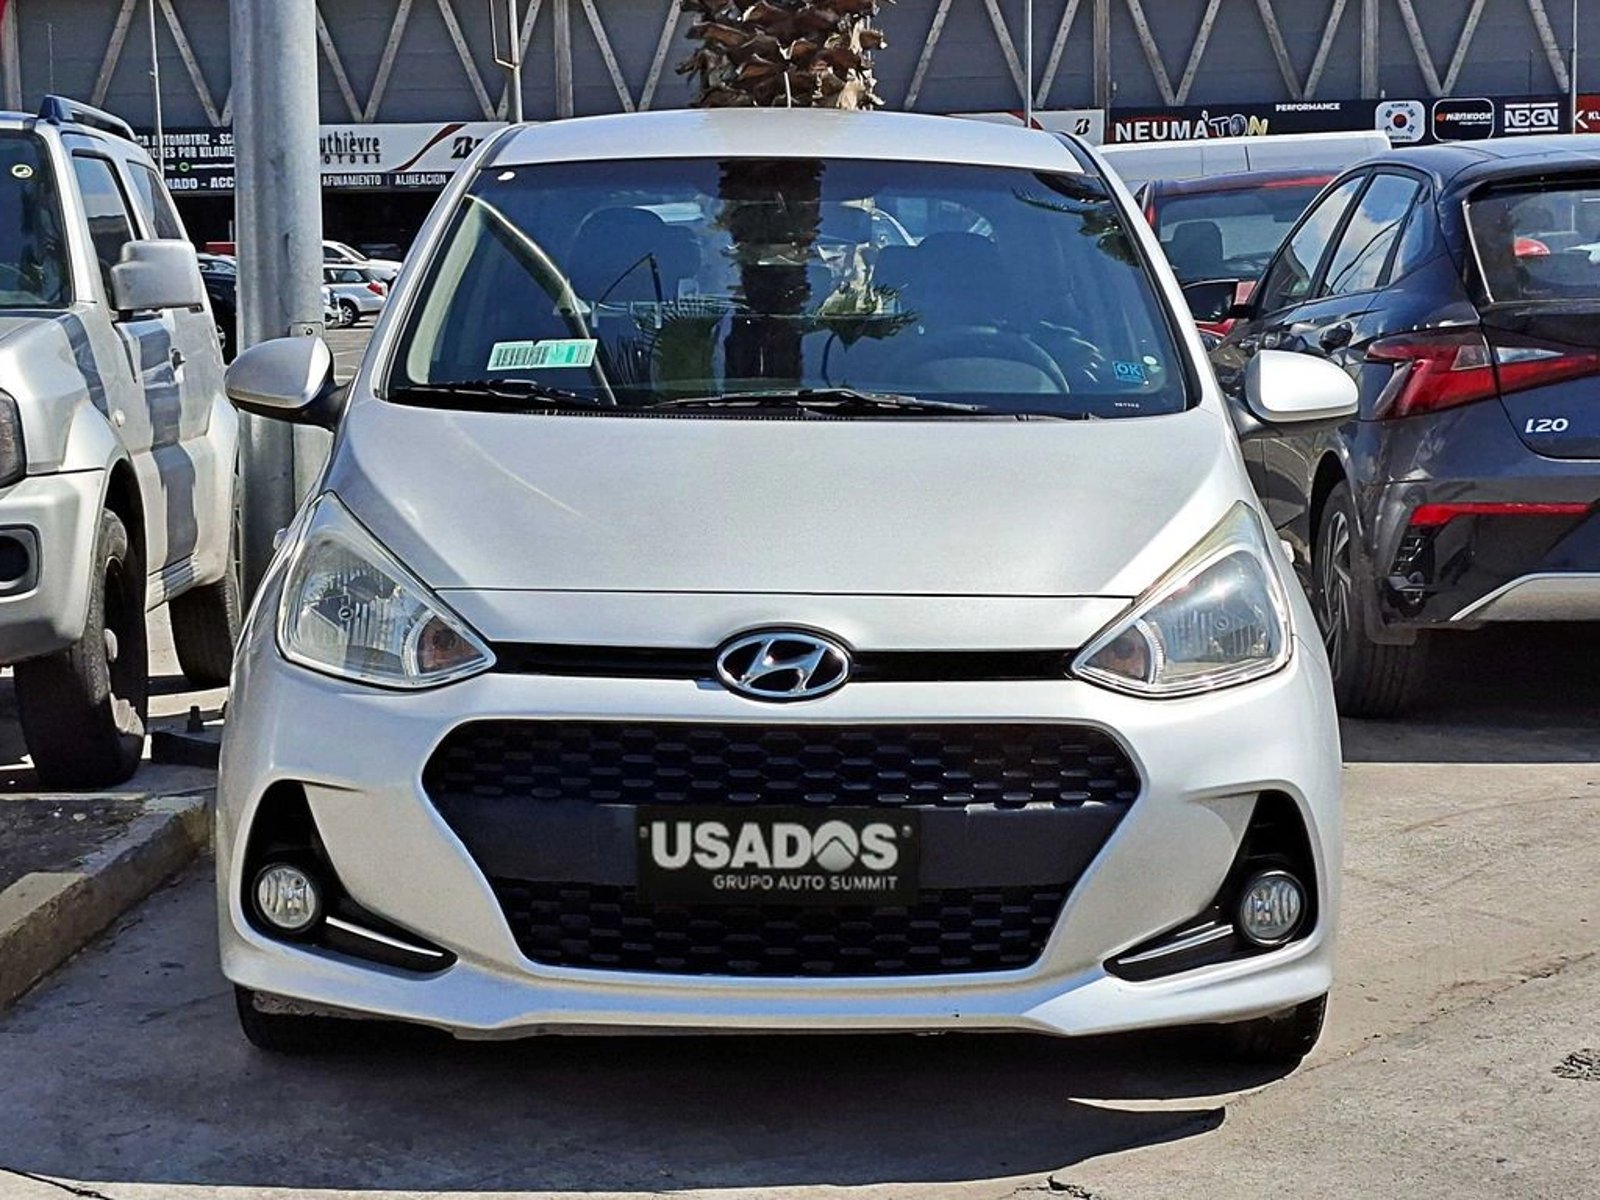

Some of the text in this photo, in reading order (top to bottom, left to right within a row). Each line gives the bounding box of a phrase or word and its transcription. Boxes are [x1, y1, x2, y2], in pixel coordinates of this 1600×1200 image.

[1275, 103, 1340, 112] PERFORMANCE
[178, 146, 198, 158] POR
[320, 153, 381, 165] OTORS
[1116, 362, 1141, 376] OK
[651, 820, 899, 873] USADOS
[713, 874, 899, 891] GRUPO AUTO SUMMIT
